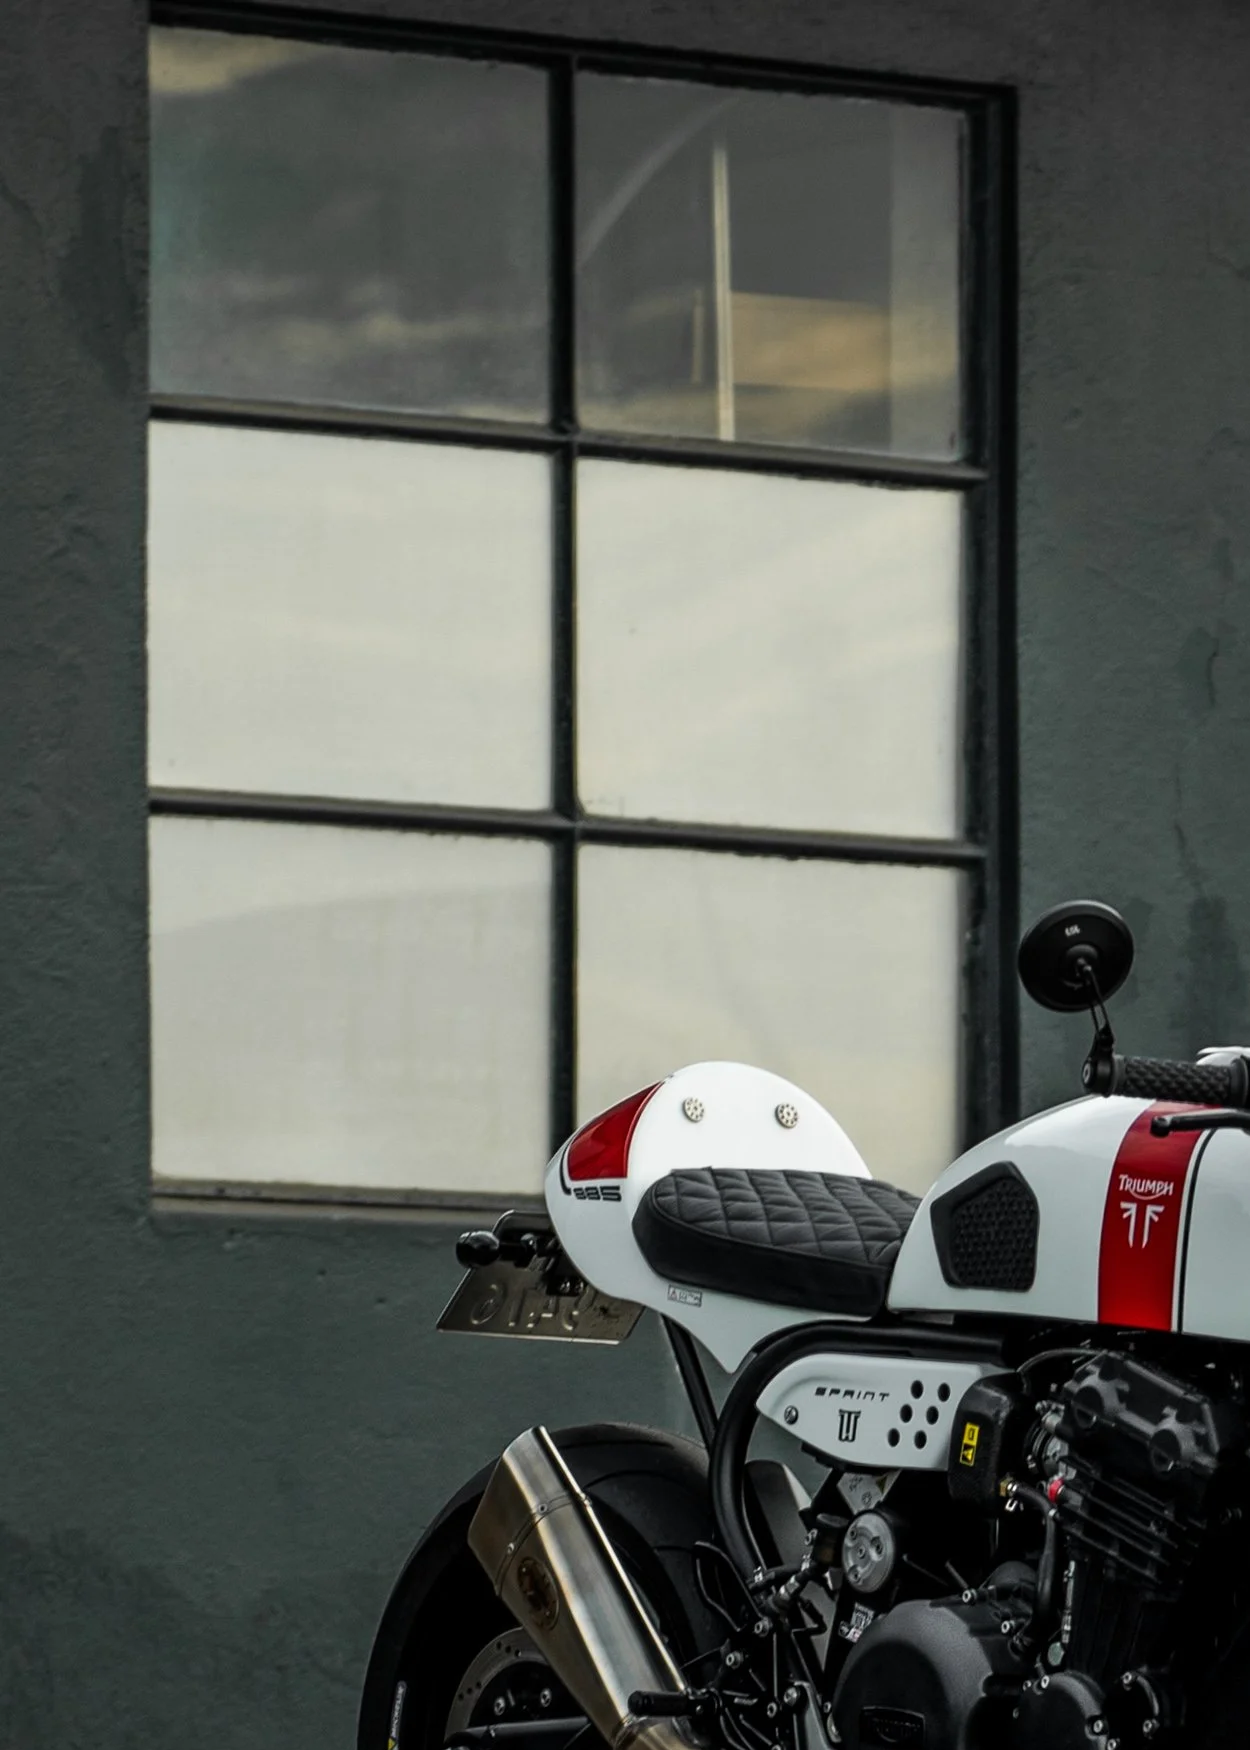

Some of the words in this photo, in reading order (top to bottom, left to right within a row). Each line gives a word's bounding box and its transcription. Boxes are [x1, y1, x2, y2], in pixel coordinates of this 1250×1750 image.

[573, 1185, 622, 1203] 885
[1118, 1174, 1174, 1199] TRIUMPH
[815, 1386, 890, 1402] SPRINT
